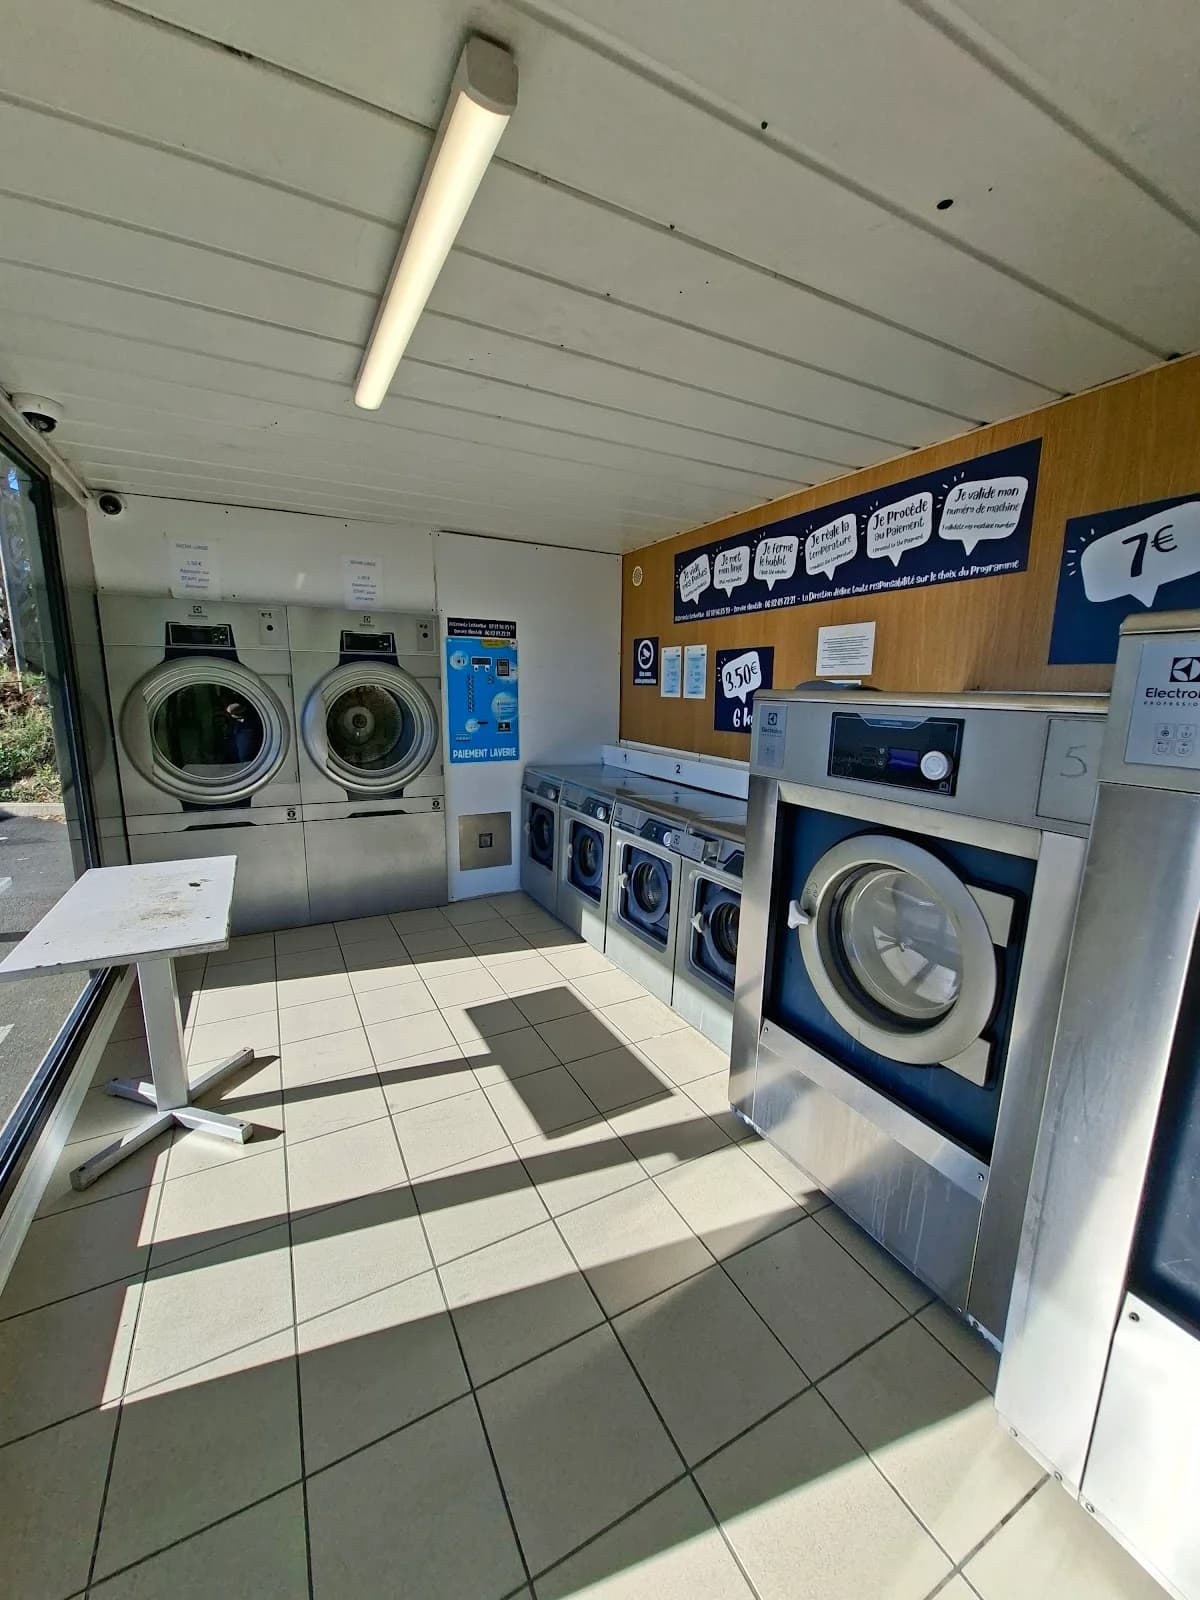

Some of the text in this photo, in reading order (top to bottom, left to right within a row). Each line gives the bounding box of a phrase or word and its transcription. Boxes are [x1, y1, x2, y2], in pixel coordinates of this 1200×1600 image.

[954, 486, 1019, 502] Je valide mon
[946, 502, 1020, 516] numéro de machine
[873, 514, 885, 530] Je
[810, 521, 850, 548] Je règle la
[874, 532, 885, 542] au
[763, 542, 794, 556] Je ferme
[809, 535, 852, 560] température
[728, 552, 742, 564] met
[760, 555, 787, 566] le hublot
[916, 574, 929, 584] sur
[930, 571, 936, 581] le
[938, 570, 957, 580] choix
[960, 566, 970, 576] du
[732, 708, 741, 728] 6
[452, 746, 516, 759] PAIEMENT LAVERIE
[675, 764, 681, 774] 2
[1060, 745, 1088, 778] 5
